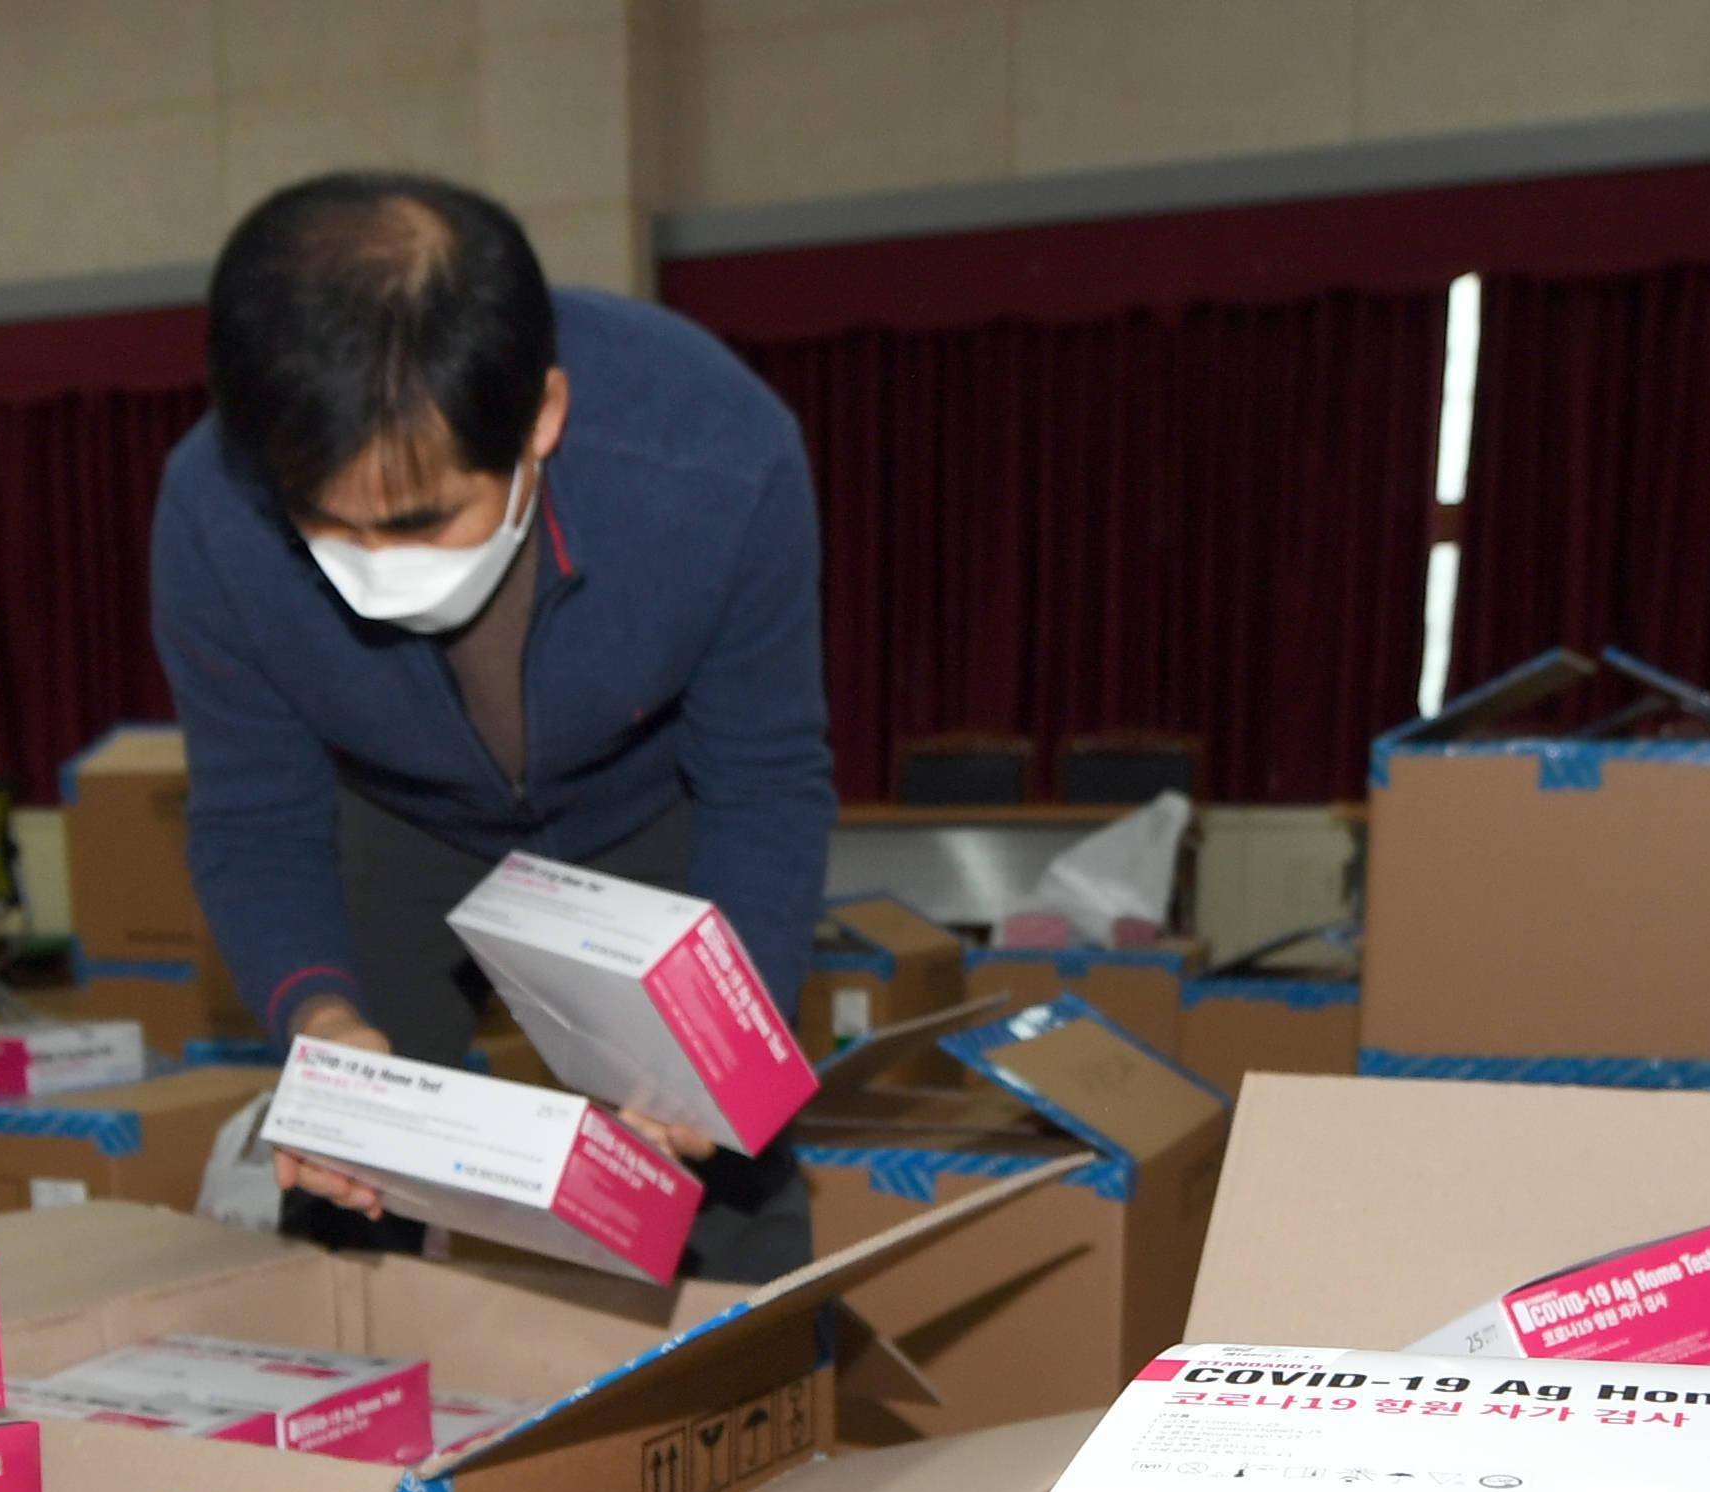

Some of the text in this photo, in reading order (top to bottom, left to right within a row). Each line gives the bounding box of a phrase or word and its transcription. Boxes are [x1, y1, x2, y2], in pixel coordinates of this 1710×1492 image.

[1612, 1274, 1634, 1303] Ag
[1183, 1366, 1472, 1394] COVID-19
[1491, 1380, 1573, 1403] Ag
[1163, 1391, 1691, 1429] 코로나19 항원 자가 검사
